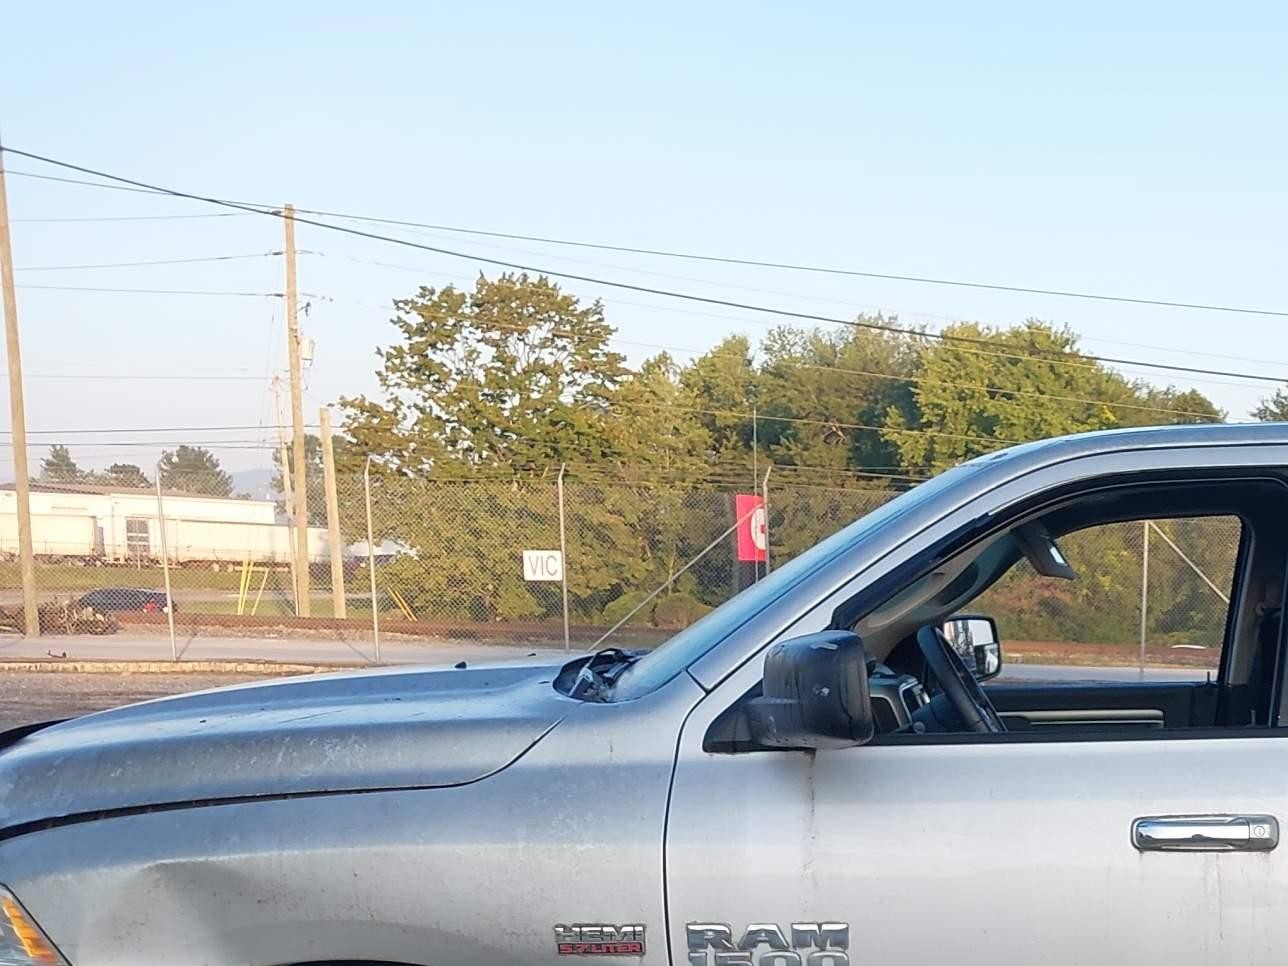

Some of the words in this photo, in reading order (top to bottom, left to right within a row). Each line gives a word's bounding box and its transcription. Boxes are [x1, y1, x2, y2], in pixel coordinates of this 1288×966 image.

[528, 555, 558, 577] VIC
[555, 925, 644, 942] HEMI
[686, 923, 849, 950] RAM
